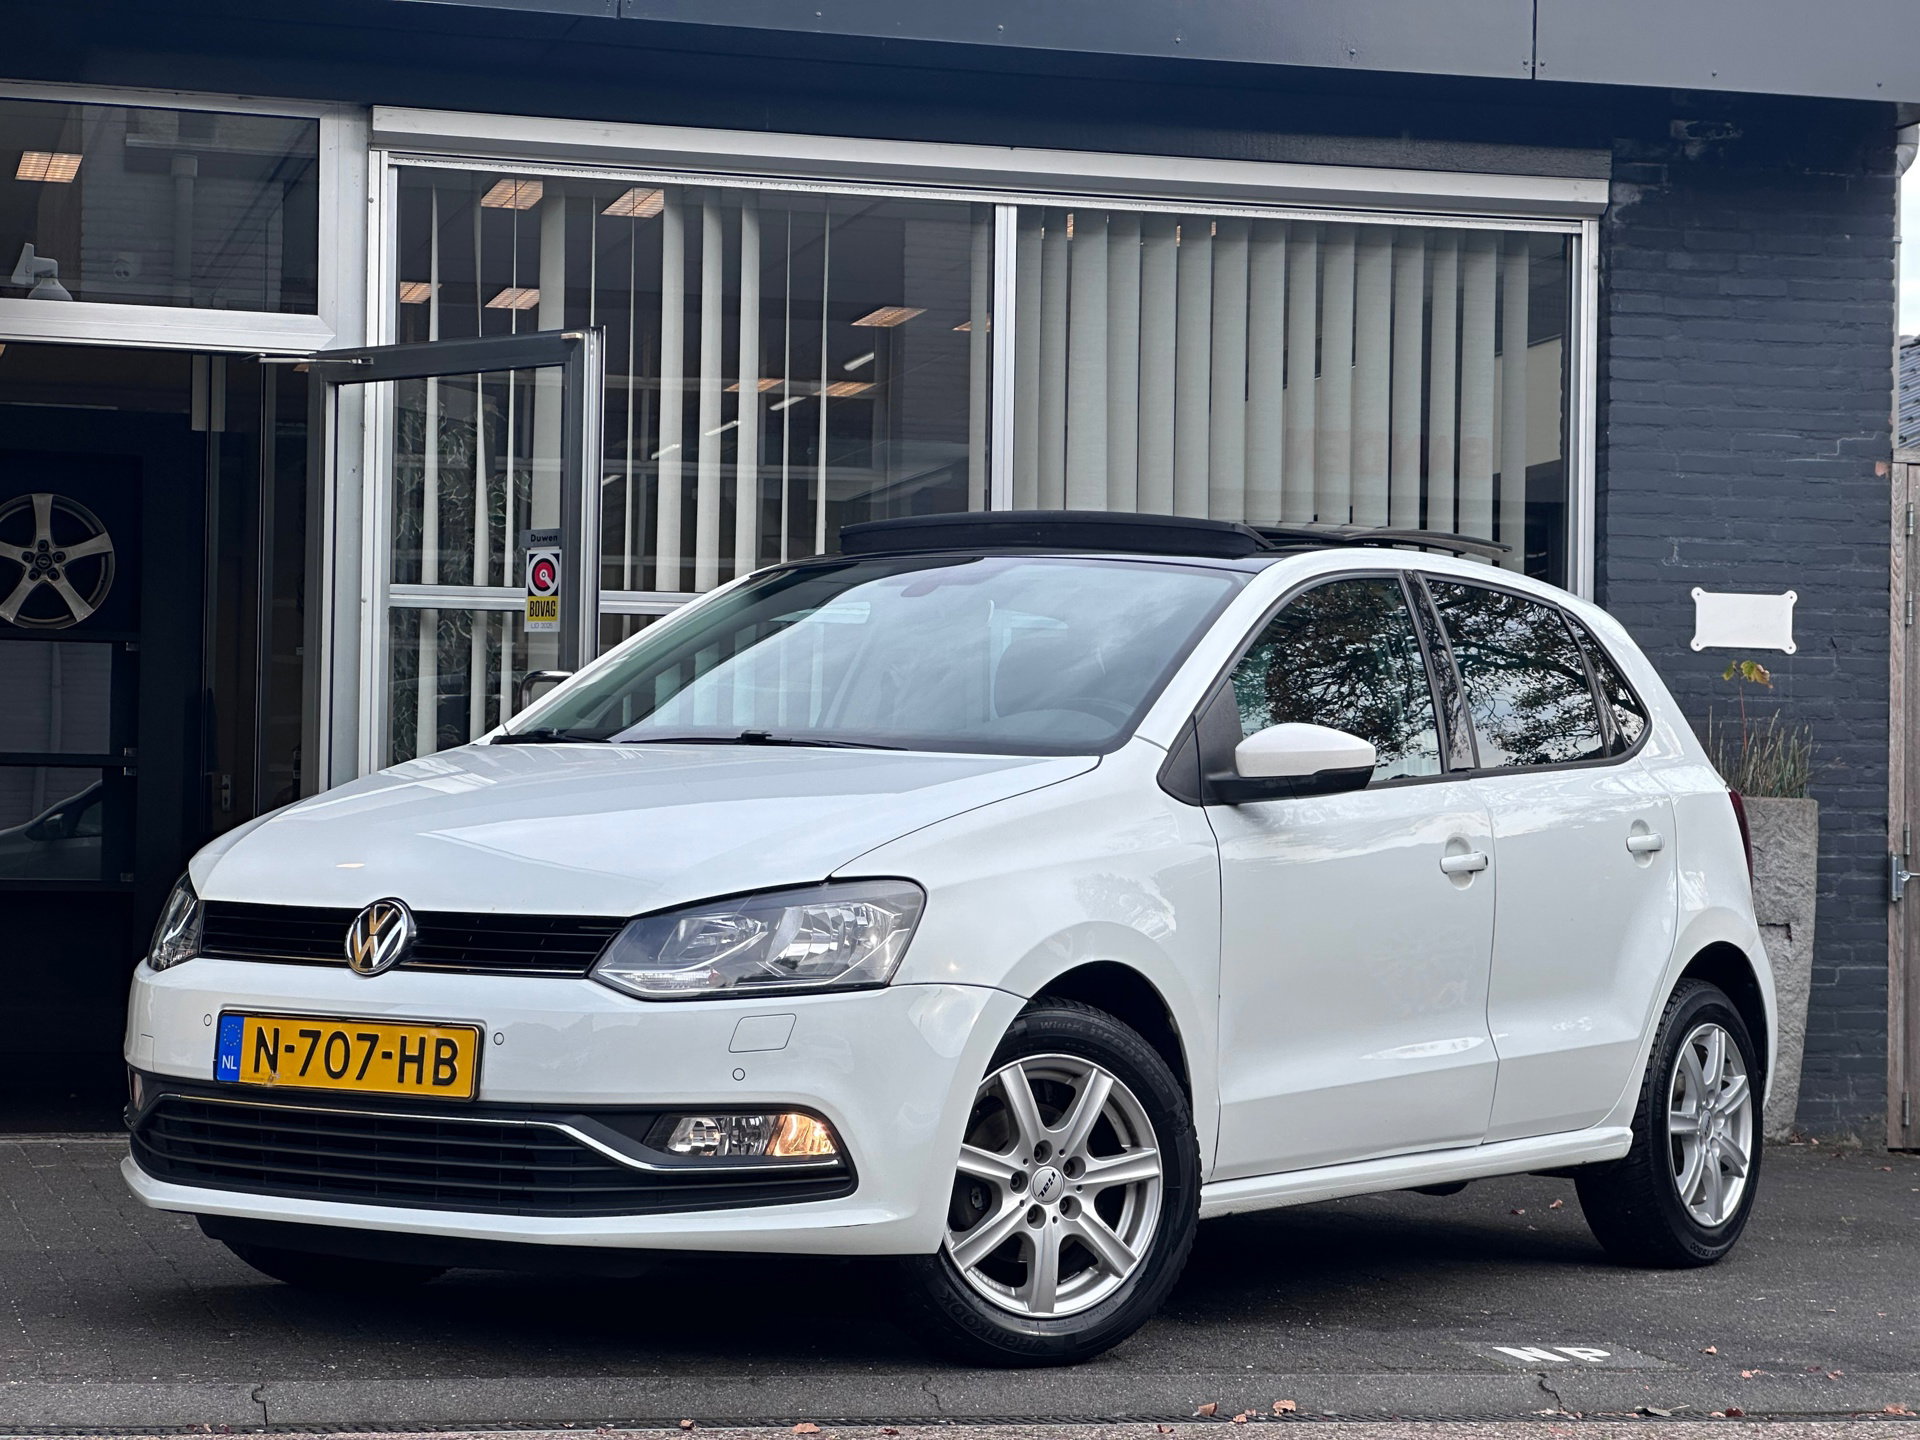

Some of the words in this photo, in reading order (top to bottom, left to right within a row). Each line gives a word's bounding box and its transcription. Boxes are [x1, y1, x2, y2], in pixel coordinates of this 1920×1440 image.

[530, 533, 558, 542] Duwen
[529, 600, 556, 617] BOVAG
[221, 1055, 238, 1070] NL
[253, 1026, 459, 1087] N-707-HB
